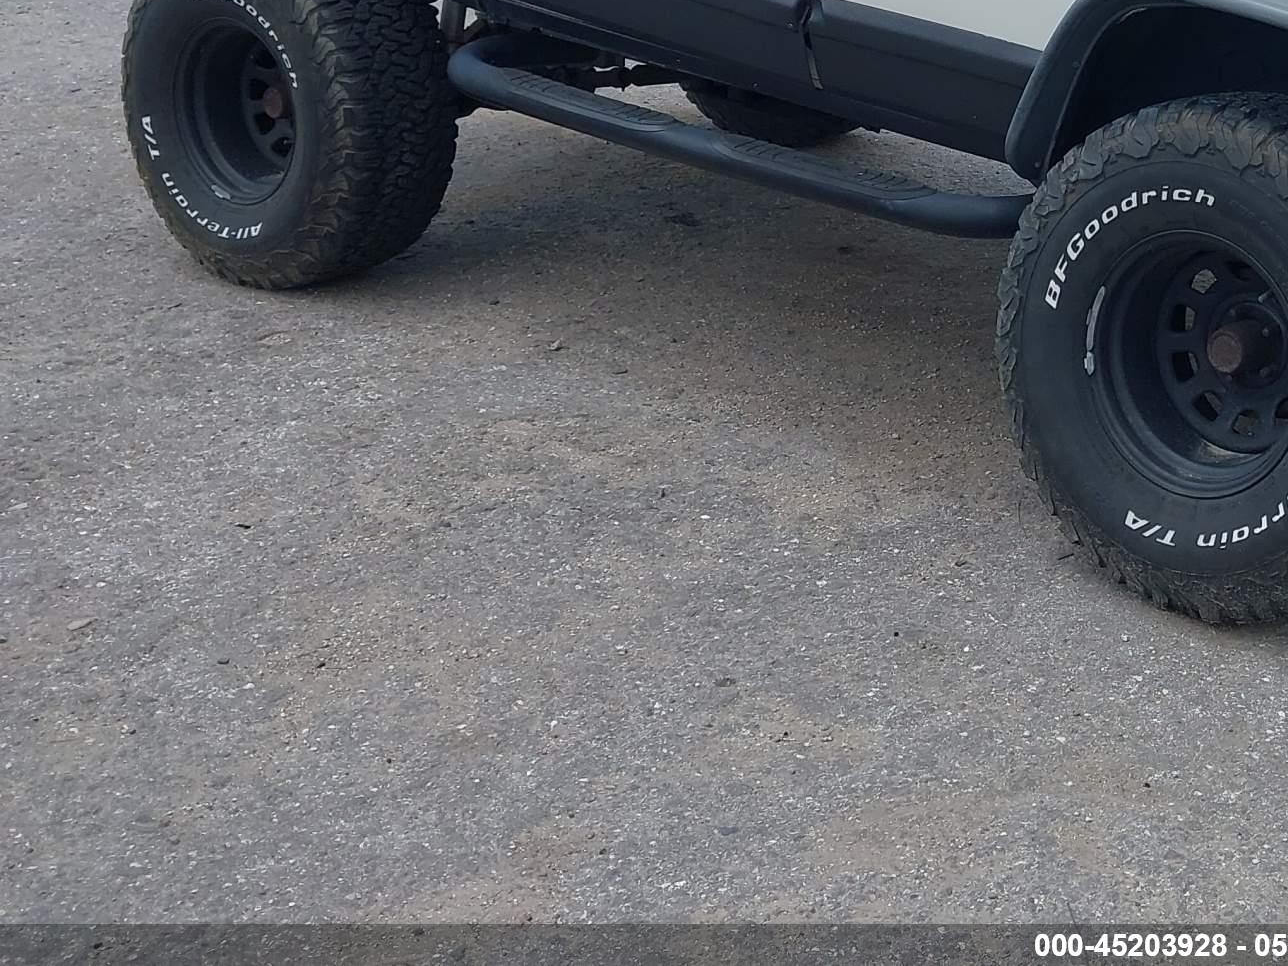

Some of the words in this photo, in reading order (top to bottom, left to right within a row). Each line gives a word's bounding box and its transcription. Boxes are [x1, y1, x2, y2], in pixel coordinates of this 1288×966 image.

[141, 115, 161, 161] T/A
[161, 172, 263, 240] All-Terrain
[1044, 185, 1216, 310] BFGoodrich
[1124, 509, 1177, 546] T/A
